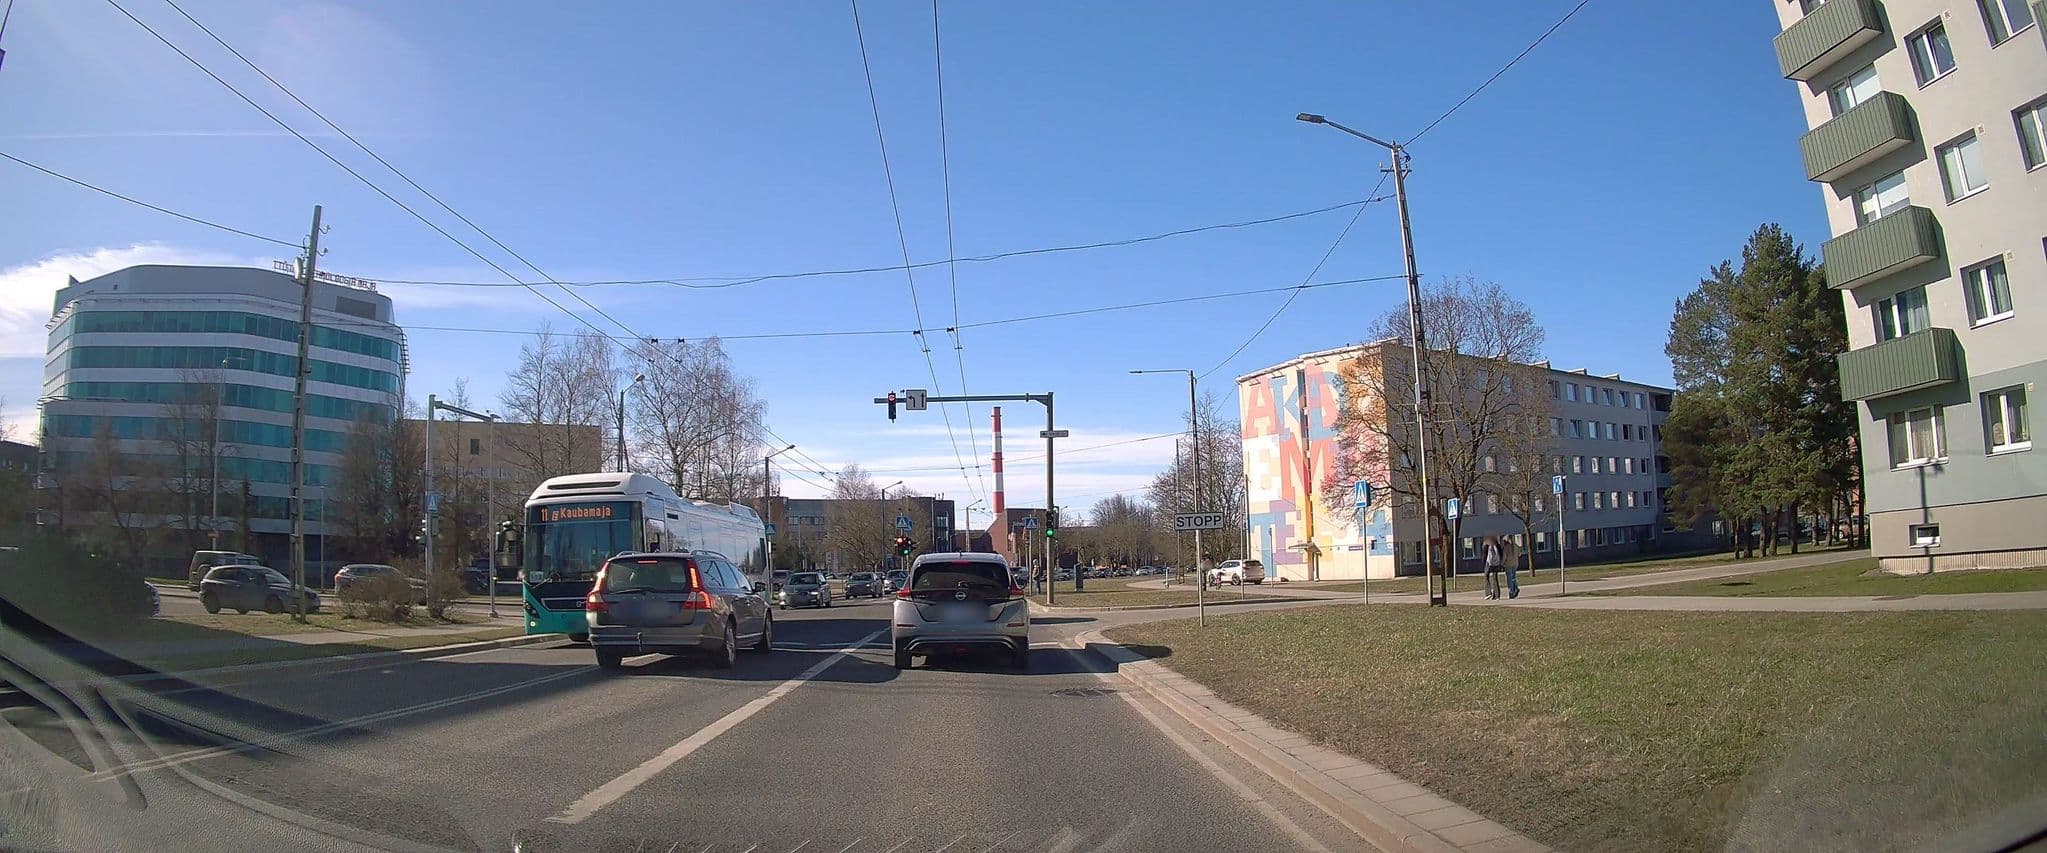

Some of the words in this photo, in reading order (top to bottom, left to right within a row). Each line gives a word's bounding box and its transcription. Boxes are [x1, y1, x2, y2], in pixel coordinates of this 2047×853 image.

[541, 508, 548, 521] 11
[560, 506, 611, 518] Kaubamaja
[1176, 515, 1222, 527] STOPP
